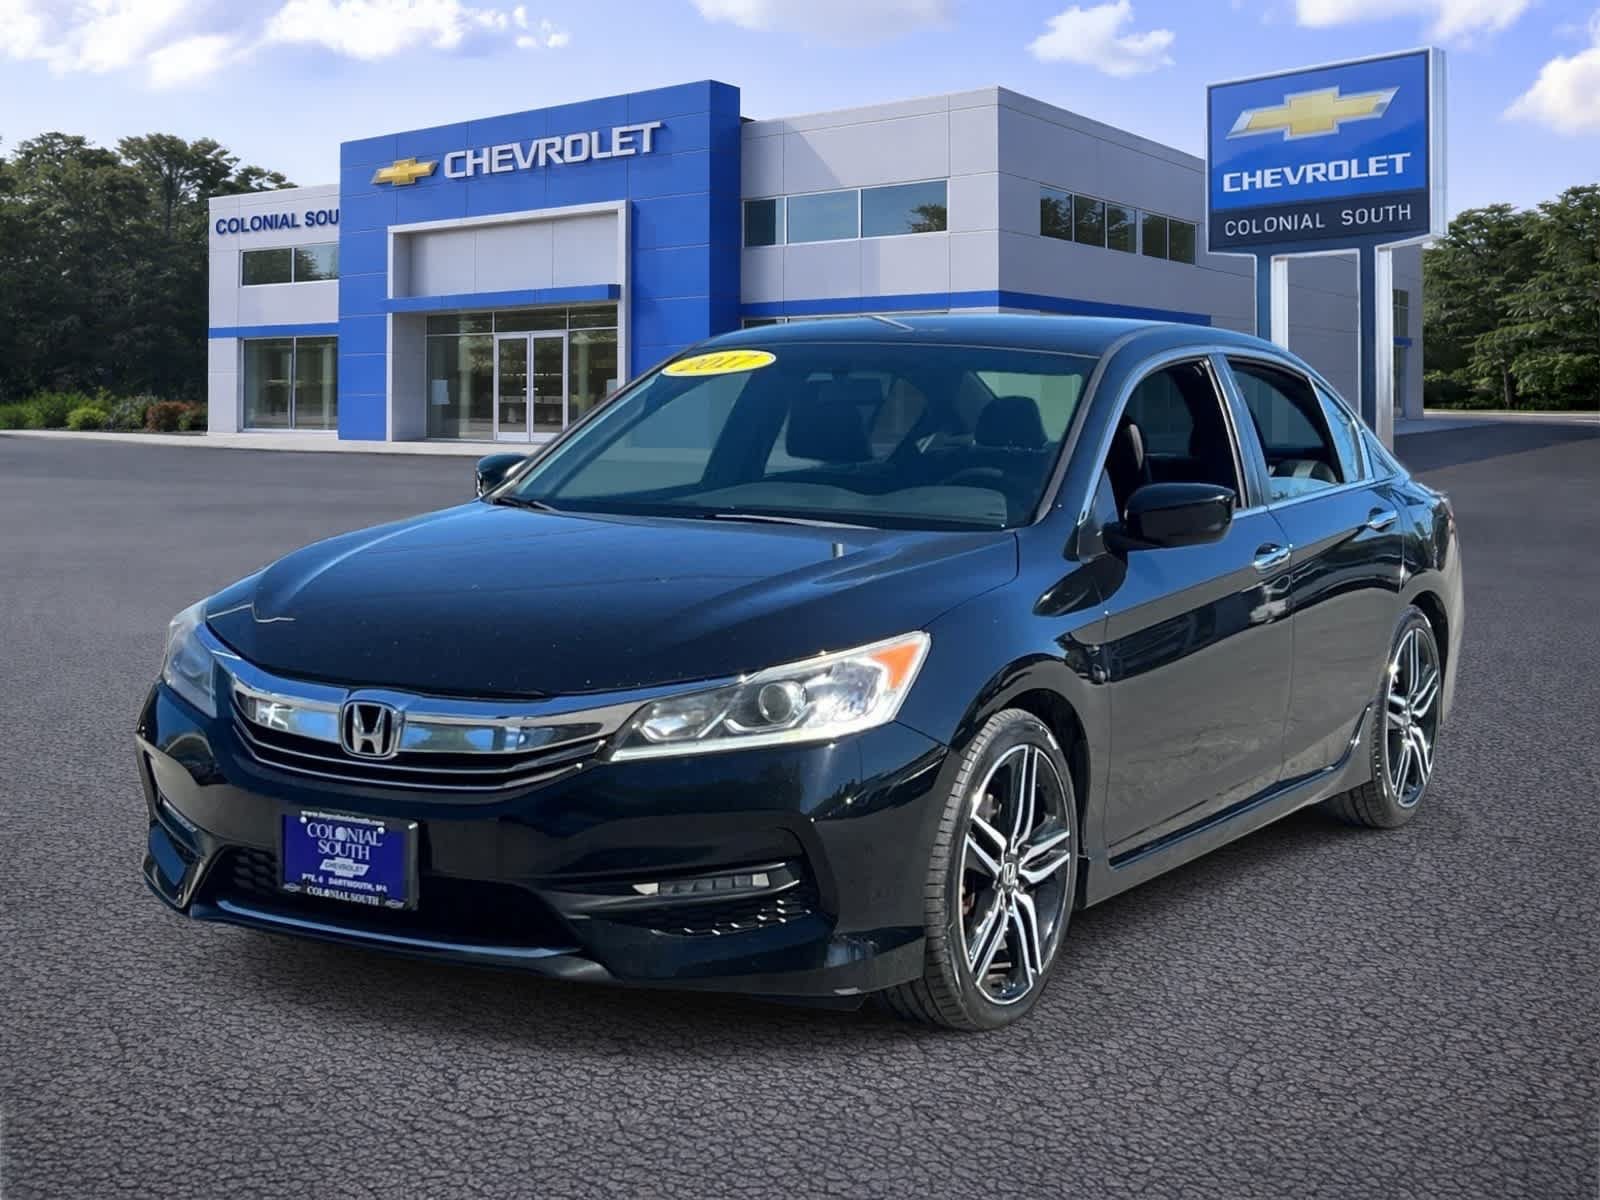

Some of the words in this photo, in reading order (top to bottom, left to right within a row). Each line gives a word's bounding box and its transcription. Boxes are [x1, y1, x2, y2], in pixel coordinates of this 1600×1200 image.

[444, 121, 662, 179] CHEVROLET
[1223, 152, 1412, 192] CHEVROLET
[215, 213, 301, 235] COLONIAL
[1225, 213, 1325, 236] COLONIAL
[1341, 203, 1412, 226] SOUTH
[307, 823, 383, 847] COLONIAL
[318, 840, 370, 860] SOUTH
[324, 861, 365, 874] CHEVROLET
[306, 886, 350, 901] COLONIAL
[351, 893, 379, 906] SOUTH
